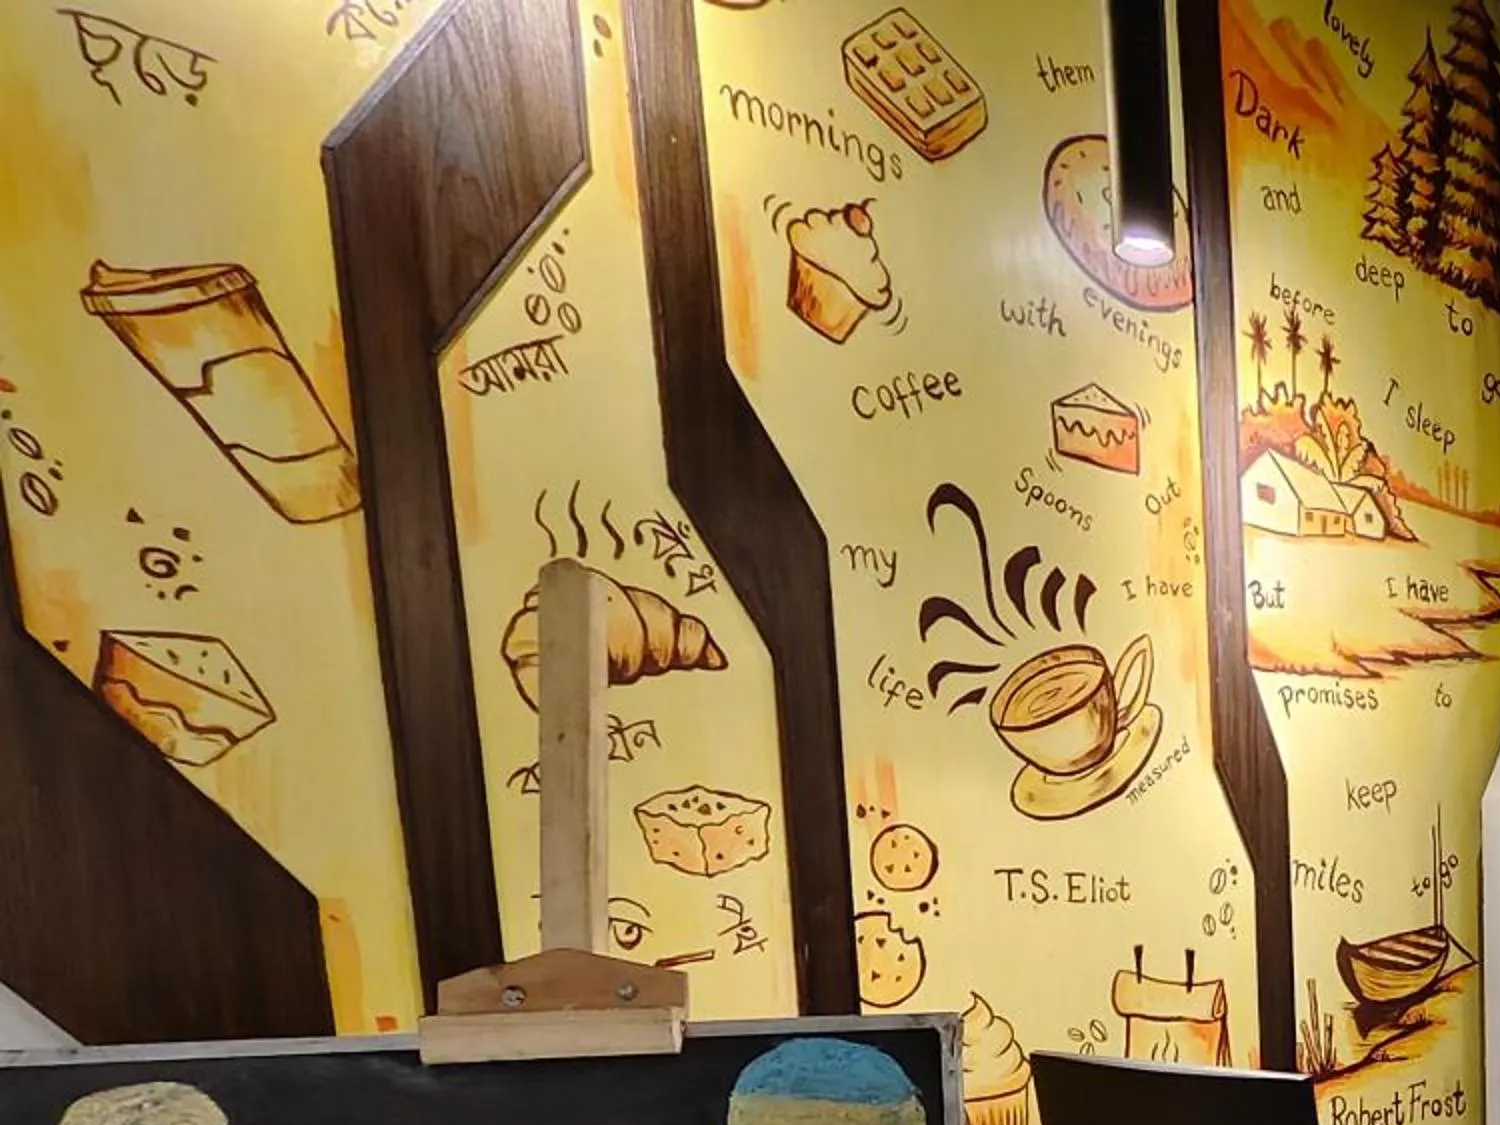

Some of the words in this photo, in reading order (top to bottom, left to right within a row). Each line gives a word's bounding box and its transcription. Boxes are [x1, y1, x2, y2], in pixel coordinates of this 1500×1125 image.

[1322, 0, 1374, 78] lovely
[1037, 54, 1094, 96] them
[720, 83, 904, 182] mornings
[1230, 69, 1305, 160] Dark
[1261, 184, 1302, 215] and
[1269, 273, 1336, 326] before
[1355, 256, 1405, 303] deep
[1001, 300, 1067, 338] with
[1083, 286, 1183, 373] evenings
[1445, 301, 1473, 337] to
[1383, 377, 1399, 406] I
[1405, 402, 1457, 455] sleep
[840, 542, 897, 589] my
[1122, 580, 1136, 600] I
[1146, 576, 1193, 598] have
[1248, 580, 1285, 610] But
[1386, 576, 1398, 598] I
[1407, 576, 1449, 603] have
[868, 654, 925, 710] life
[1278, 682, 1379, 719] promises
[1435, 684, 1453, 708] to
[1126, 735, 1191, 805] measured
[1345, 778, 1397, 814] keep
[1293, 855, 1365, 904] miles
[1408, 1080, 1466, 1123] Frost
